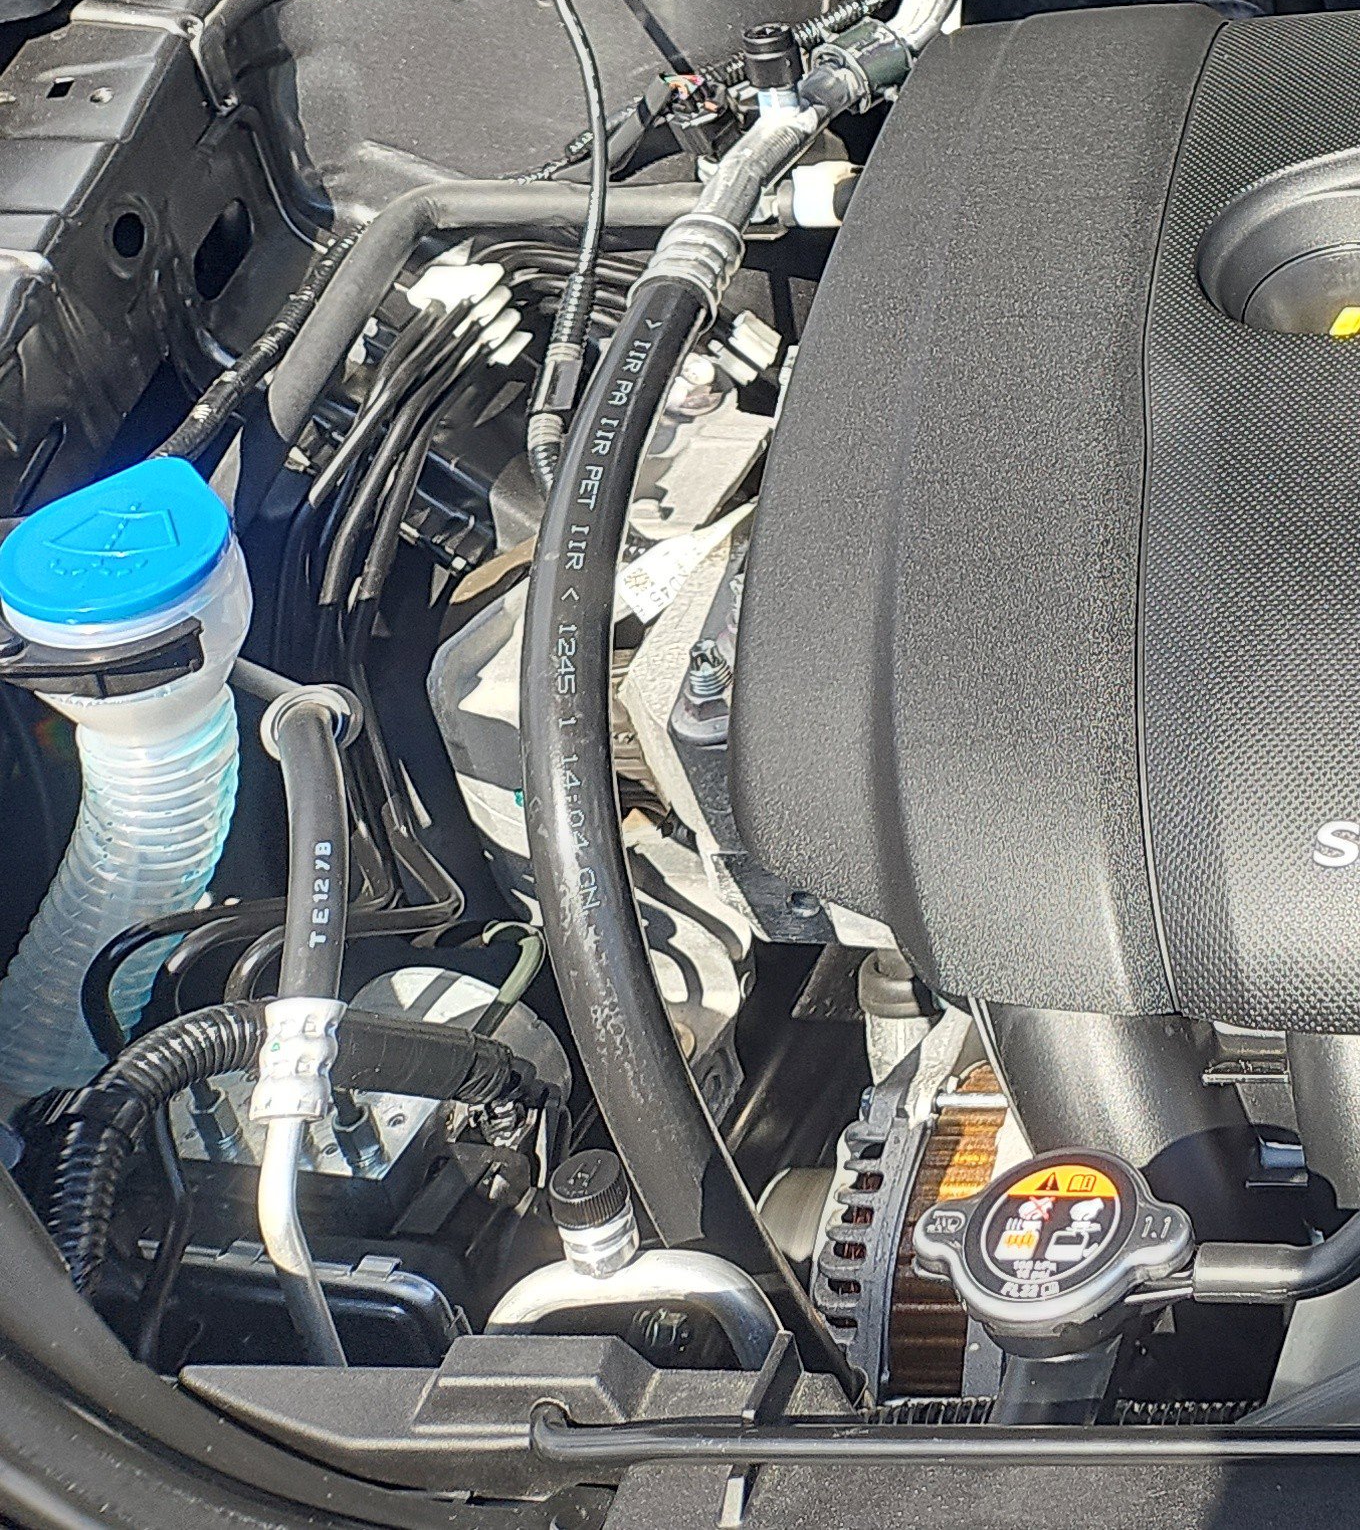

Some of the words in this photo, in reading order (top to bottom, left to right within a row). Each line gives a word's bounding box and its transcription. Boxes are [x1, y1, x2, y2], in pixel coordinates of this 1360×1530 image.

[607, 379, 635, 406] PA
[577, 464, 604, 511] PET
[564, 524, 590, 570] IIR
[555, 624, 578, 695] 1245
[1141, 1215, 1172, 1239] 1.1
